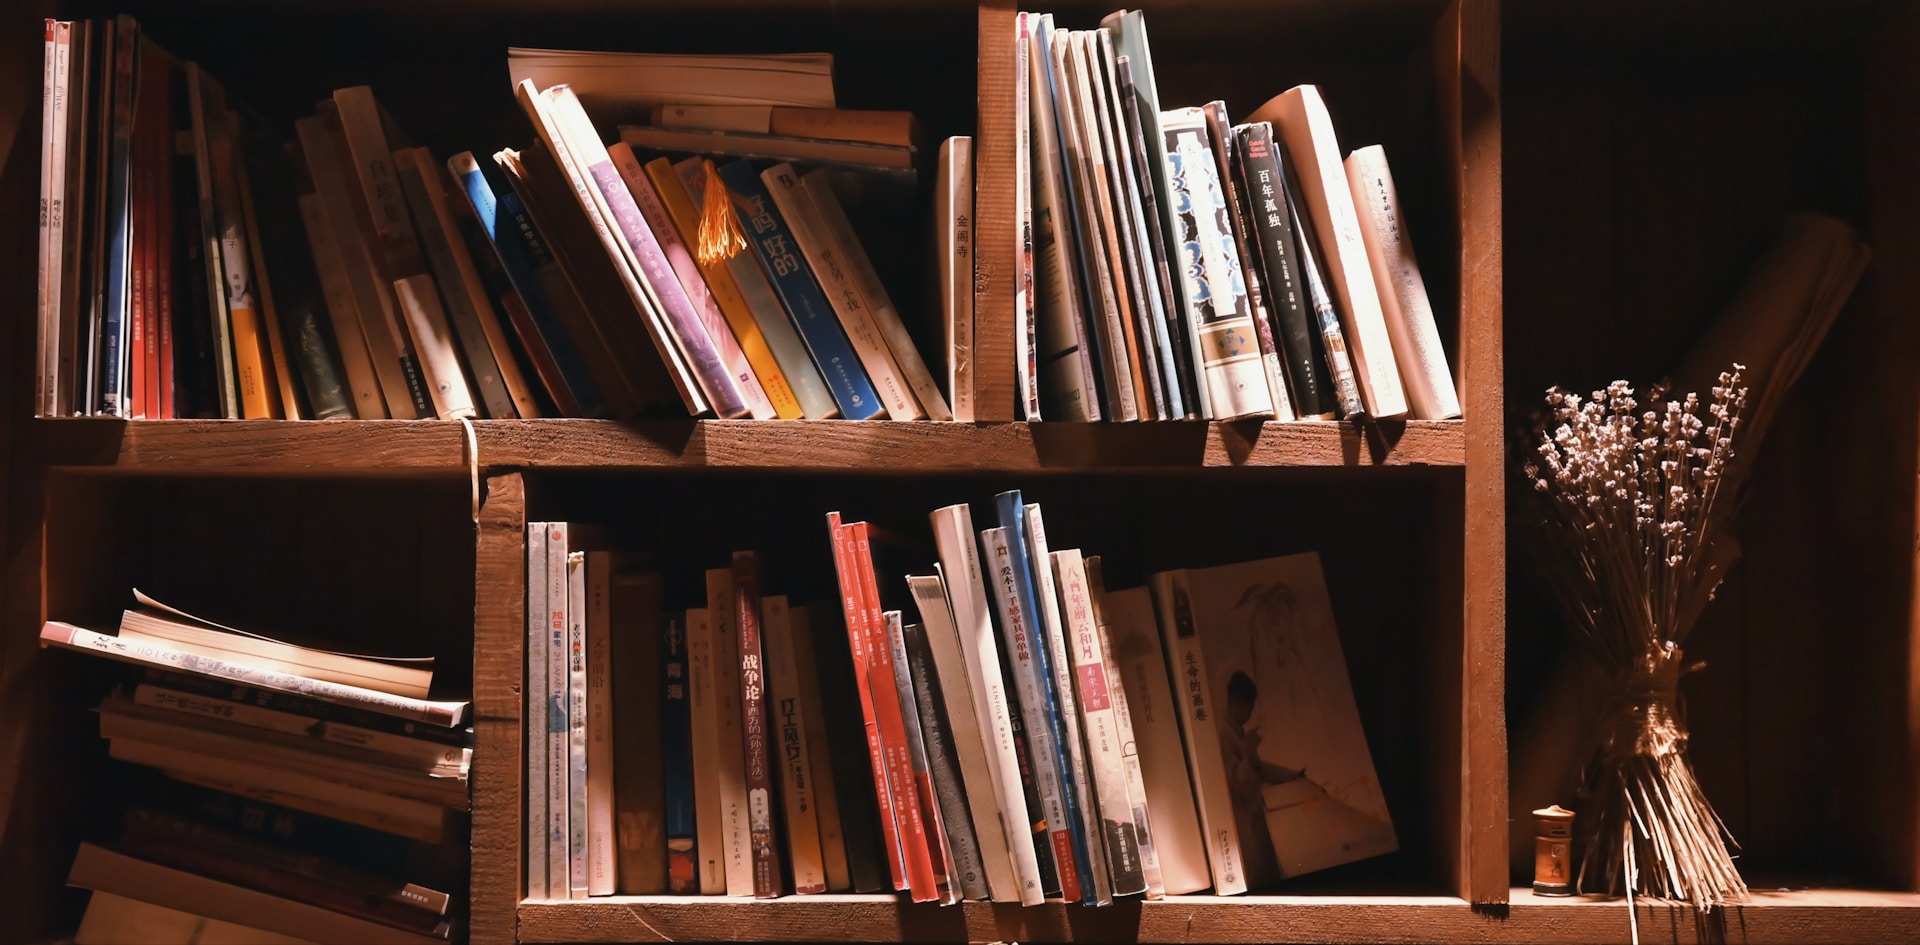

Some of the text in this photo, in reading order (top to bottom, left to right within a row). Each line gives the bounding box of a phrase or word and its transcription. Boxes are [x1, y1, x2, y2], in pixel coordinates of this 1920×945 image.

[1258, 168, 1282, 229] 百年孤独
[956, 214, 968, 258] 金阁寺
[552, 611, 563, 629] 知日
[1000, 566, 1031, 661] 爱木工 手感家具简单做
[1067, 566, 1093, 660] 八百年前云和月
[666, 662, 684, 701] 青海
[991, 685, 1003, 721] KINFOLK
[1185, 650, 1207, 722] 生命的画卷
[780, 697, 800, 762] 打工旅行
